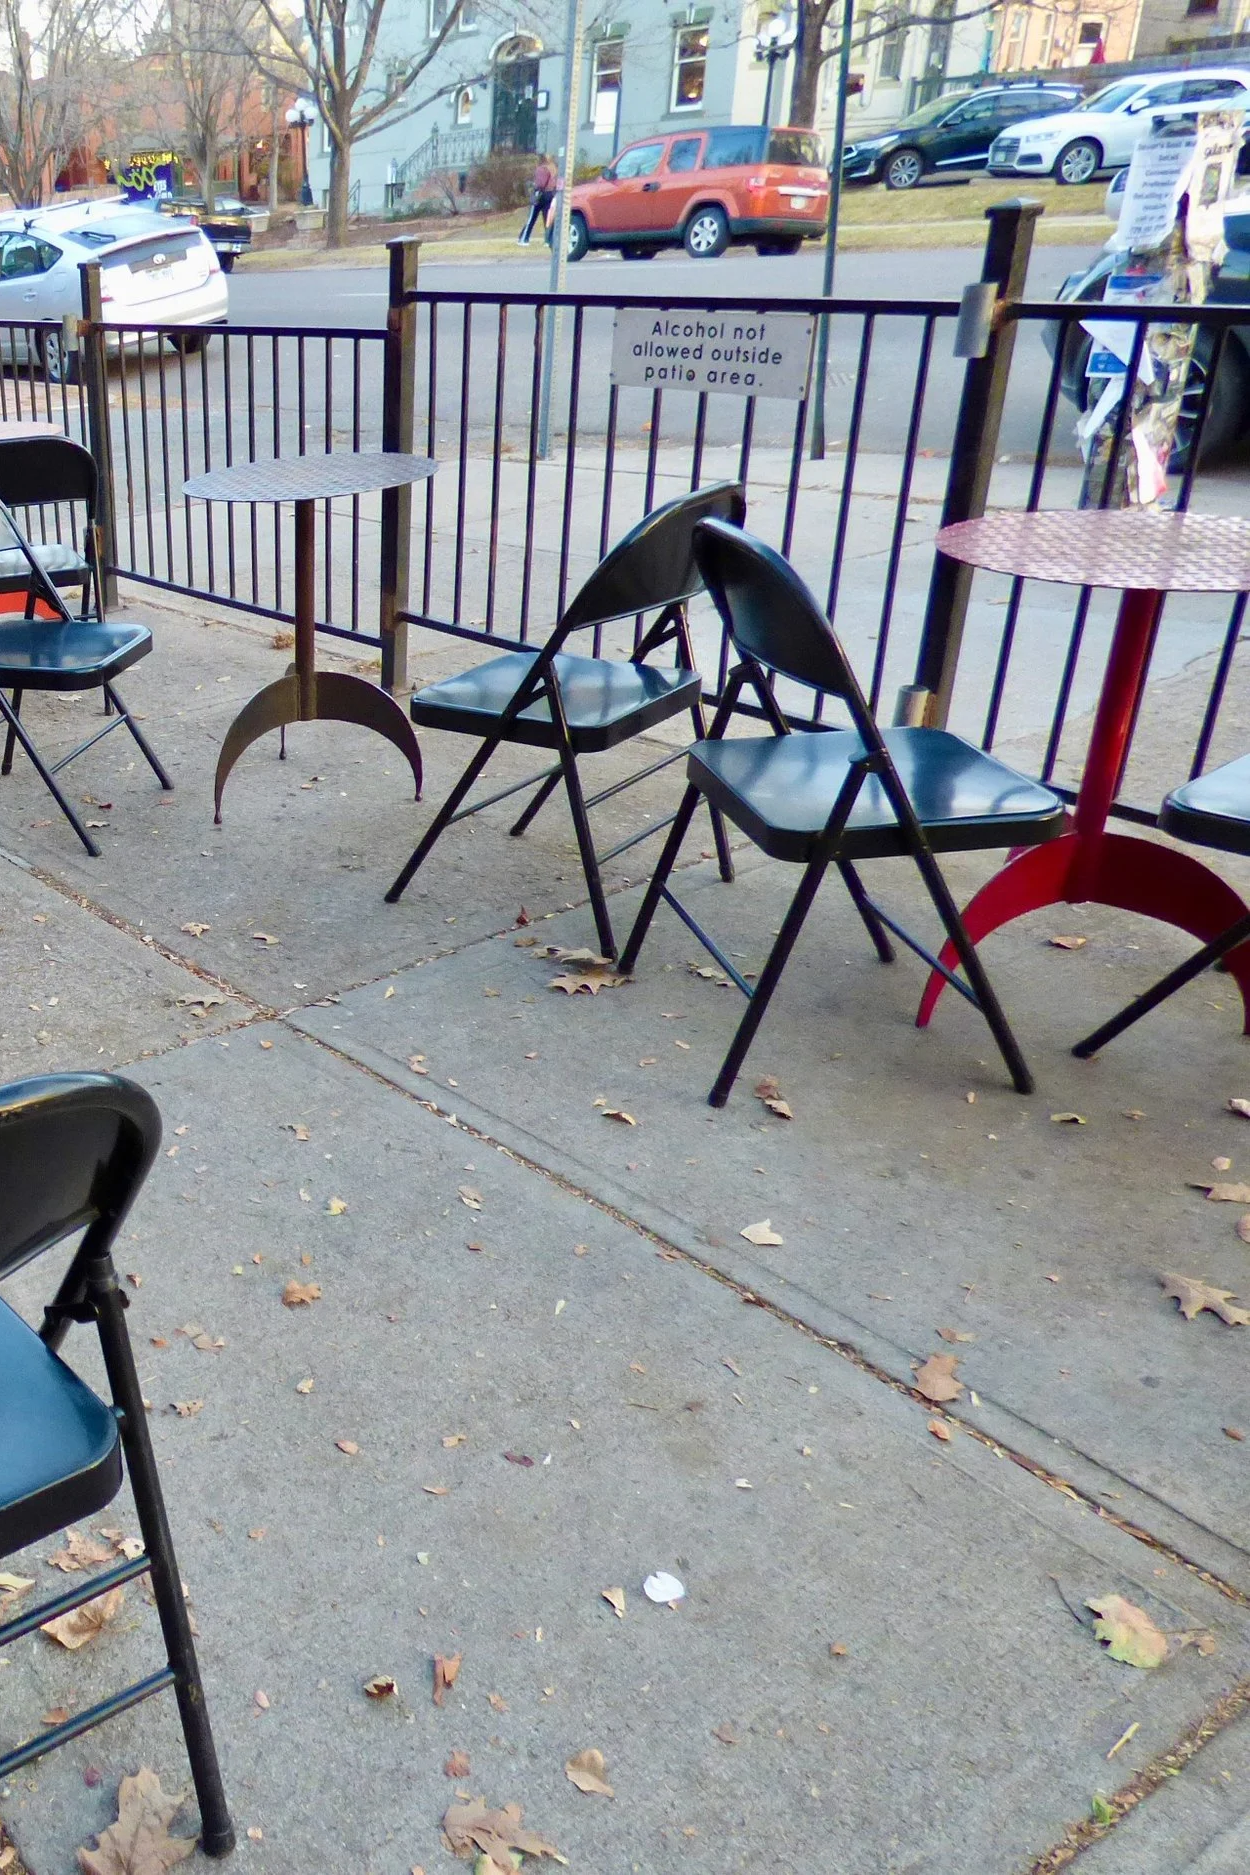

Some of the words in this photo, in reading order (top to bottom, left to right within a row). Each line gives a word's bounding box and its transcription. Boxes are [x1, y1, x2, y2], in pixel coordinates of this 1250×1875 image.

[652, 320, 725, 338] Alcohol
[733, 324, 766, 341] not
[632, 341, 704, 360] allowed
[711, 347, 783, 365] outside
[644, 364, 696, 382] patio
[706, 370, 763, 387] area.
